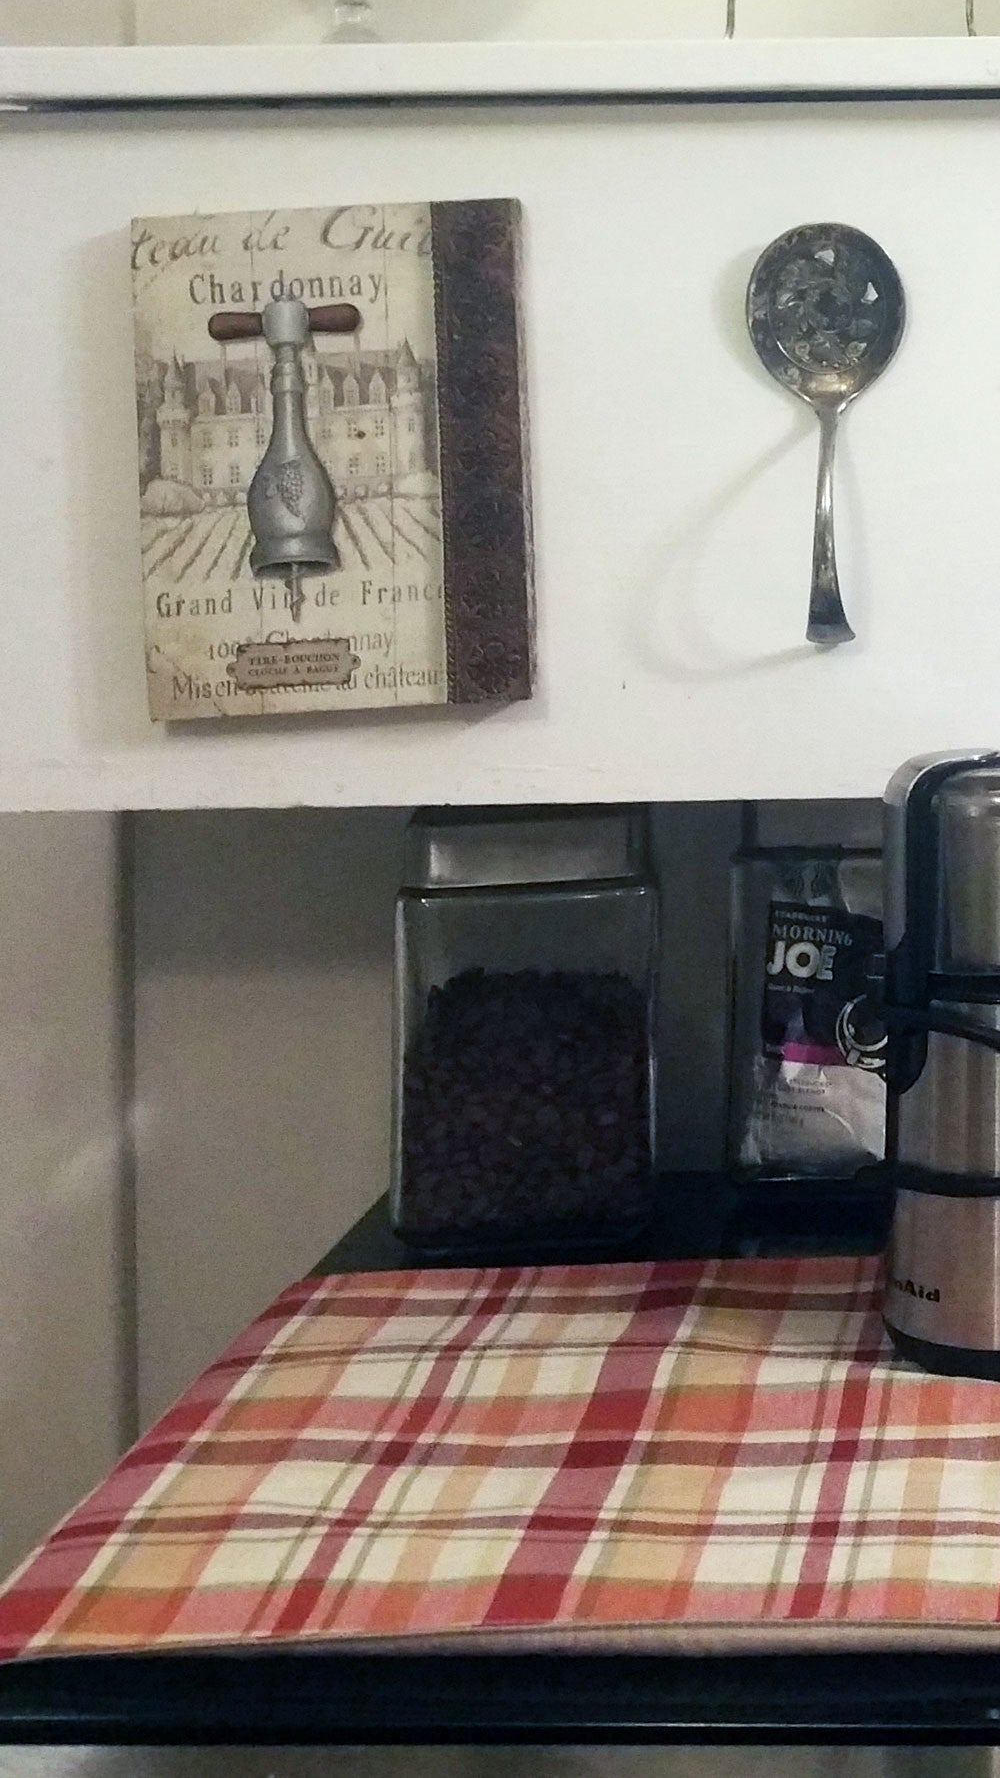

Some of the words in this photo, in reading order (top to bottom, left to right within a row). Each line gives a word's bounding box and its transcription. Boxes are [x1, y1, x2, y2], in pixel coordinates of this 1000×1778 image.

[189, 269, 381, 305] Chardonnay
[156, 588, 232, 618] Grand
[315, 582, 340, 607] de
[772, 923, 853, 946] MORNING
[766, 940, 837, 980] JOE
